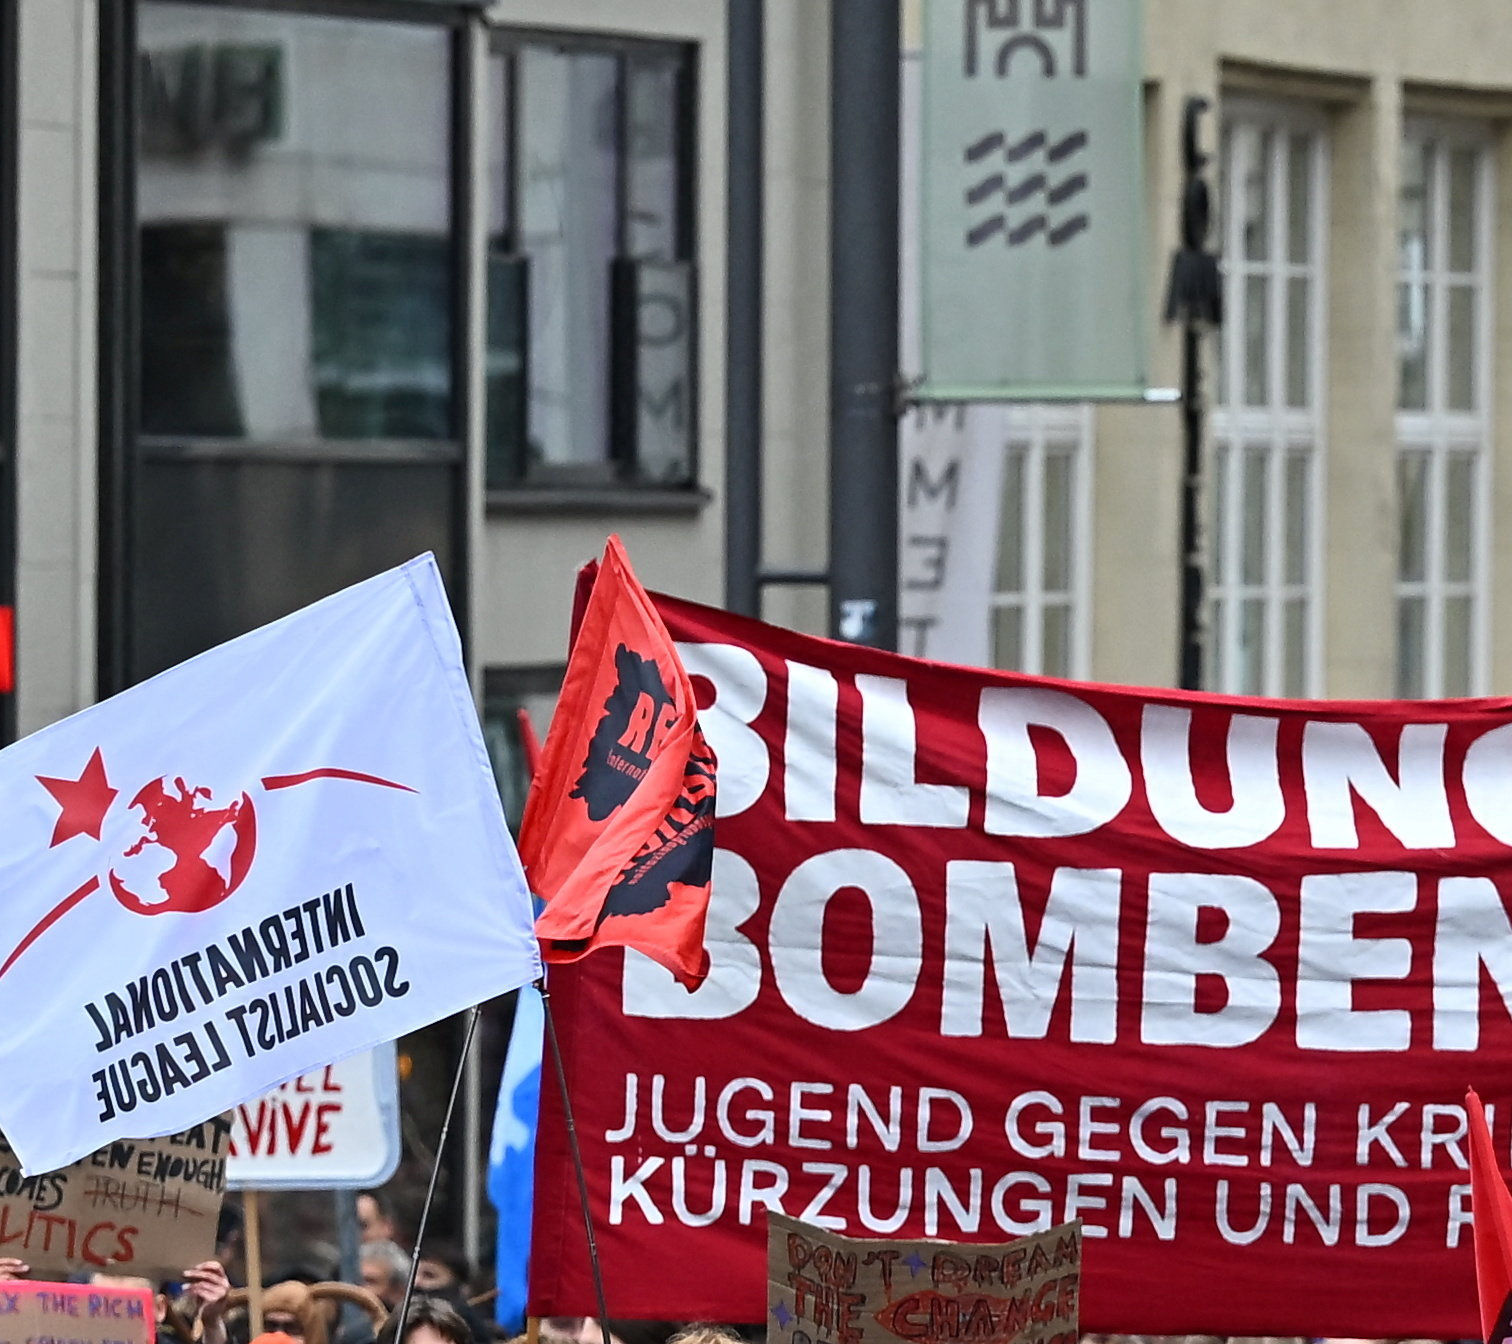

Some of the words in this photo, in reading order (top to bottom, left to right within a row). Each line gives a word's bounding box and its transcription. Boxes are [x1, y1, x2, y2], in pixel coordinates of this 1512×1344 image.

[604, 1071, 975, 1153] JUGEND
[1004, 1089, 1315, 1169] GEGEN
[608, 1142, 1178, 1240] KÜRZUNGEN
[1214, 1180, 1411, 1248] UND
[787, 1231, 901, 1292] DON'T
[930, 1231, 1078, 1291] DREAM
[35, 1291, 80, 1318] THE
[88, 1292, 144, 1319] RICH
[890, 1272, 1079, 1339] CHANGE
